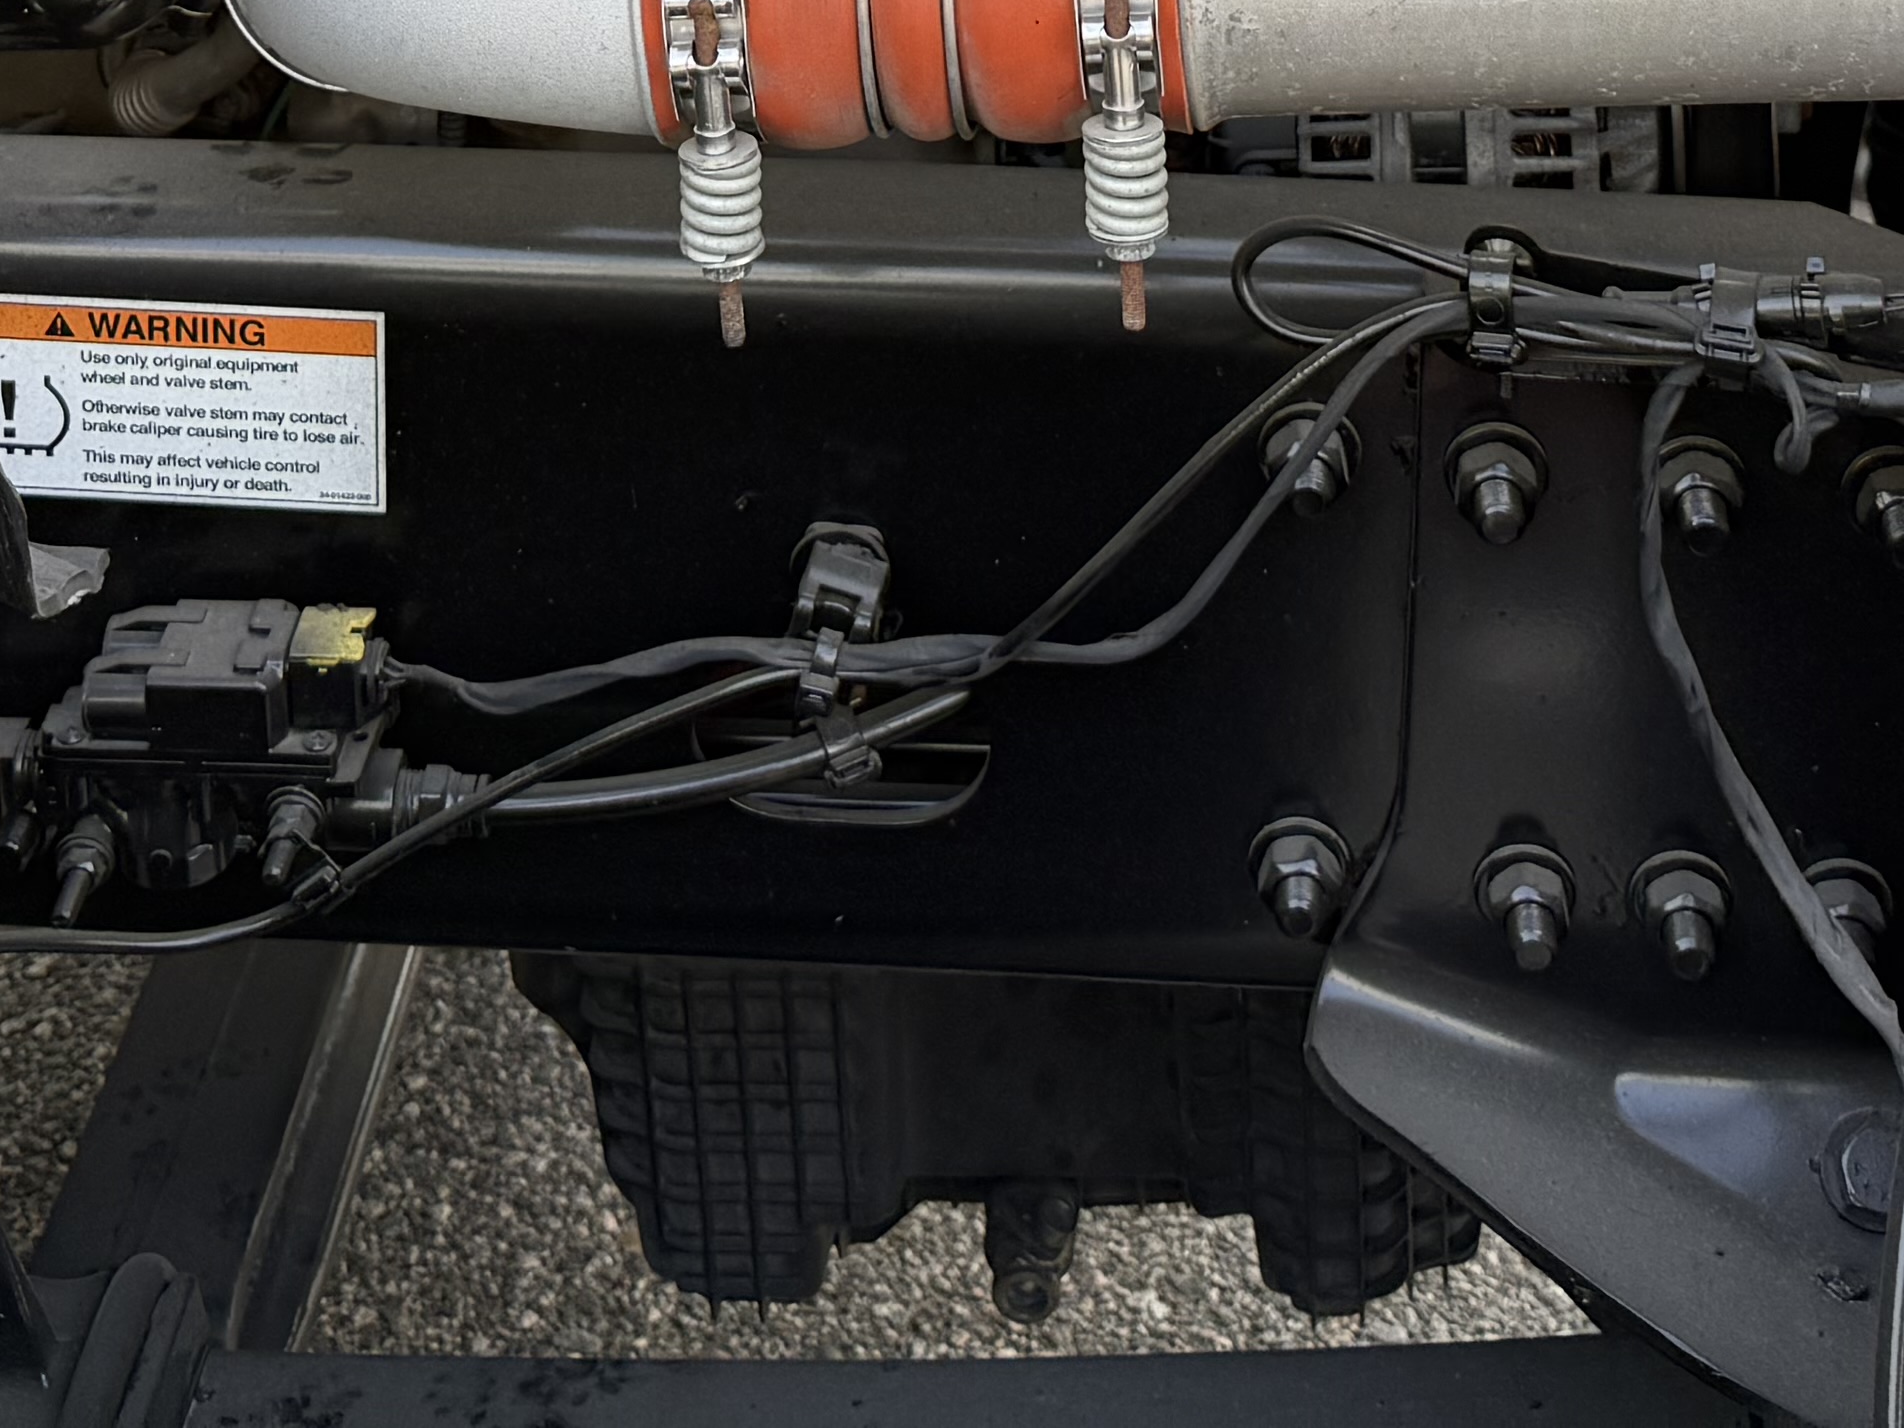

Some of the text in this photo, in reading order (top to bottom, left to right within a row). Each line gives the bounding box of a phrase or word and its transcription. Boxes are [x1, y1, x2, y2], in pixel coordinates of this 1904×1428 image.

[88, 311, 266, 347] WARNING
[80, 350, 299, 375] Use only original equipment
[81, 370, 253, 391] wheel and valve stem.
[82, 399, 348, 426] Otherwise valve stem may contact
[82, 418, 365, 446] brake caliper causing tire to lose air.
[82, 449, 320, 474] This may affect vehicle control
[83, 469, 292, 493] resulting in injury or death.
